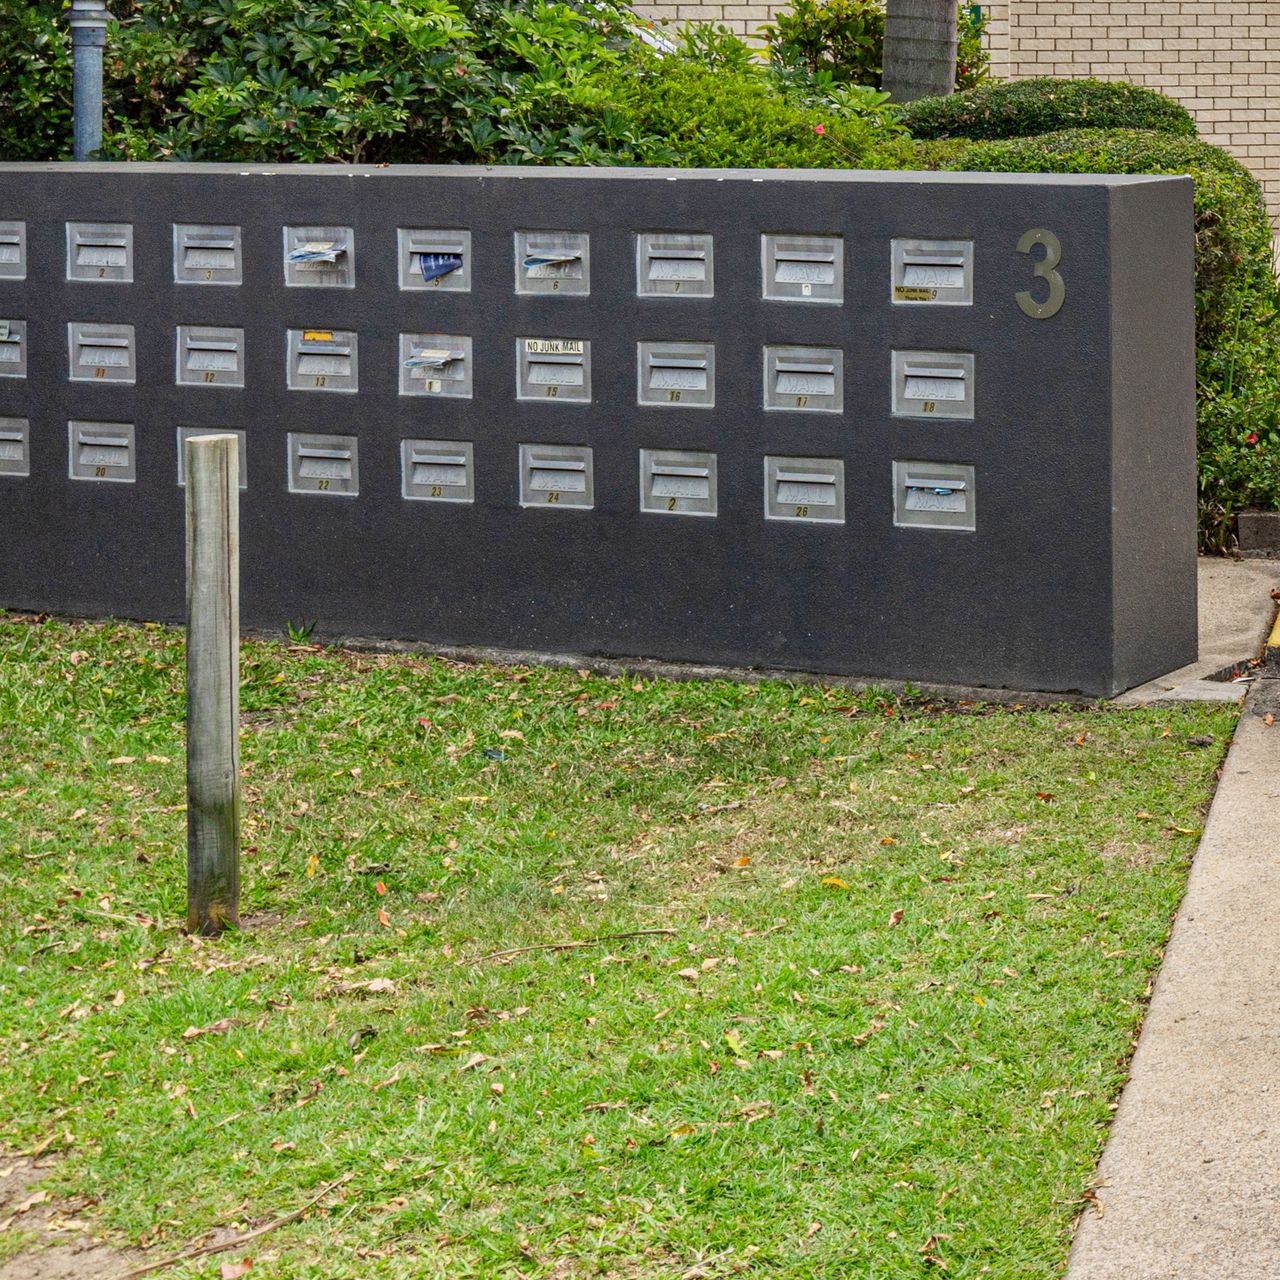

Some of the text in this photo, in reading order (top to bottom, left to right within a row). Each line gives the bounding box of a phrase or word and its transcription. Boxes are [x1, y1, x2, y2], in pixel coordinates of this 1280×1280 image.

[100, 268, 106, 277] 2
[206, 270, 213, 280] 3
[1014, 227, 1066, 319] 3
[553, 281, 560, 290] 6
[674, 282, 681, 291] 7
[931, 290, 938, 300] 9
[527, 341, 581, 352] NO JUNK MAIL
[96, 368, 105, 377] 11
[205, 373, 215, 382] 12
[315, 377, 326, 386] 13
[547, 387, 558, 397] 15
[670, 391, 681, 401] 16
[798, 397, 808, 407] 17
[924, 402, 935, 412] 18
[96, 467, 106, 476] 20
[318, 480, 330, 489] 22
[431, 487, 442, 496] 23
[548, 493, 559, 502] 24
[797, 507, 808, 517] 26
